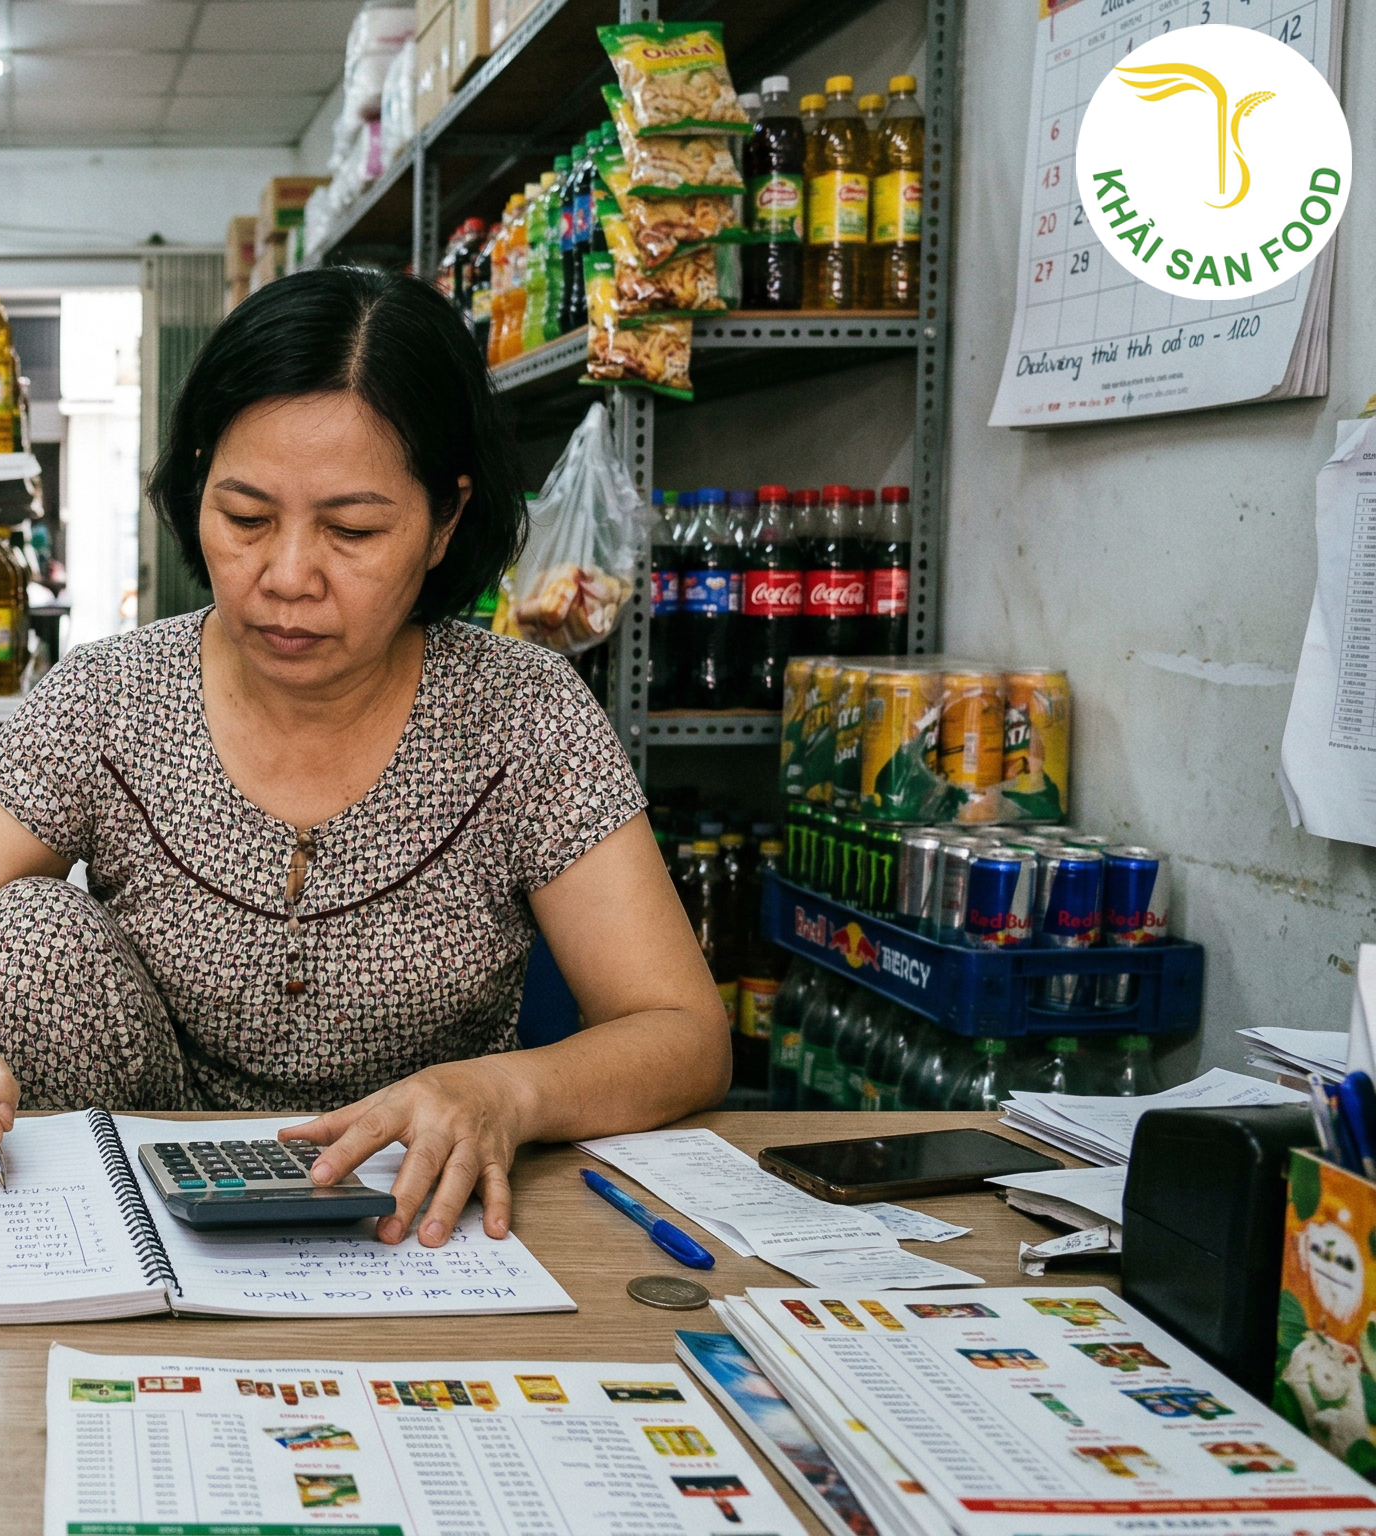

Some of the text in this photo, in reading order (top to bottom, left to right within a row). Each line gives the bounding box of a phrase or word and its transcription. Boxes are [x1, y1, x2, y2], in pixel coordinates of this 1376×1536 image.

[1200, 1, 1211, 25] 3
[1278, 14, 1302, 44] 12
[1051, 119, 1060, 141] 6
[1042, 166, 1061, 189] 13
[1037, 212, 1057, 236] 20
[1034, 260, 1054, 283] 27
[970, 909, 1003, 928] Red
[1058, 910, 1092, 927] Red
[323, 1290, 372, 1301] Coca
